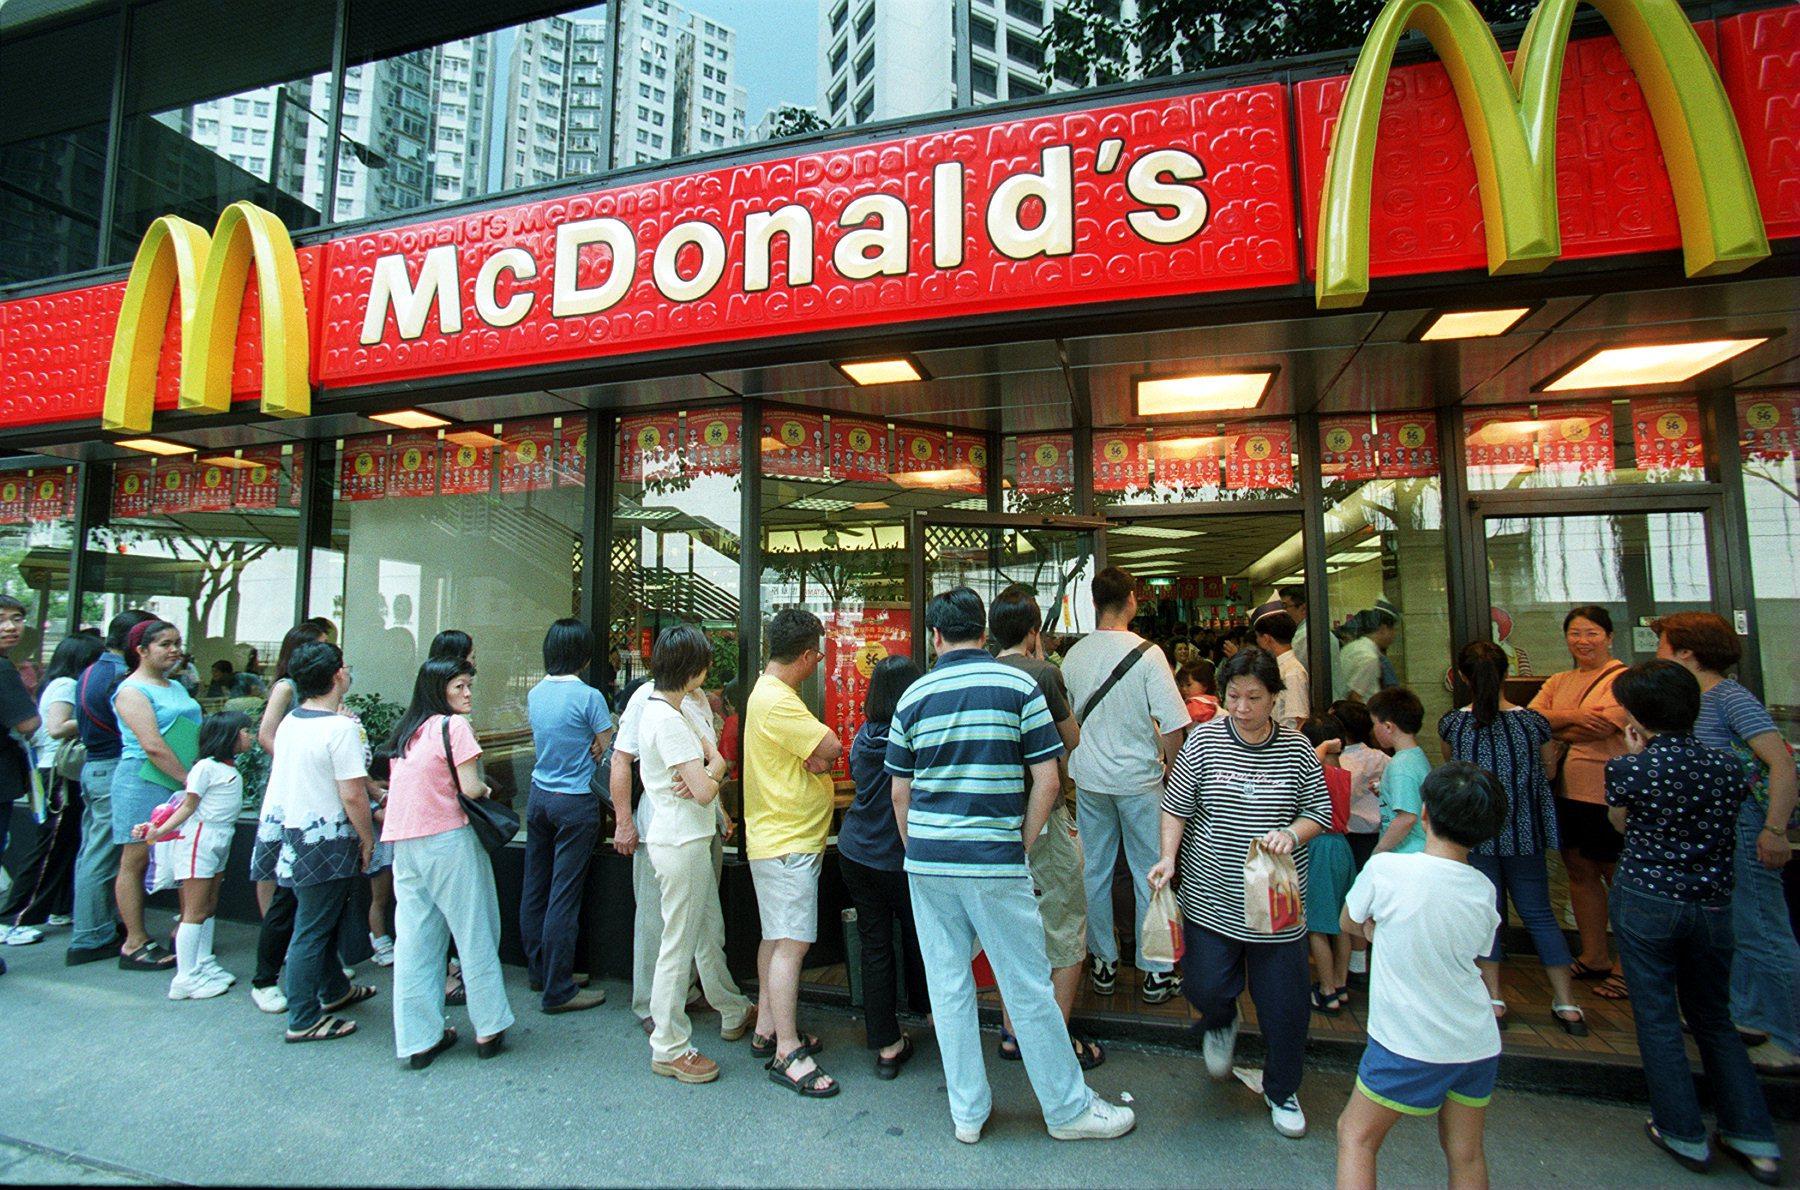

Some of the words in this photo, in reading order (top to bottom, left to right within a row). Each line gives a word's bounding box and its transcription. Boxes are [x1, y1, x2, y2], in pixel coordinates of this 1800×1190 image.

[513, 175, 722, 236] McDonald's
[729, 133, 977, 196] McDonald's
[985, 91, 1276, 157] McDonald's
[360, 138, 1209, 345] McDonald's
[506, 302, 717, 350] McDonald's
[726, 270, 979, 322] McDonald's
[989, 236, 1284, 293] McDonald's
[866, 652, 880, 666] $6
